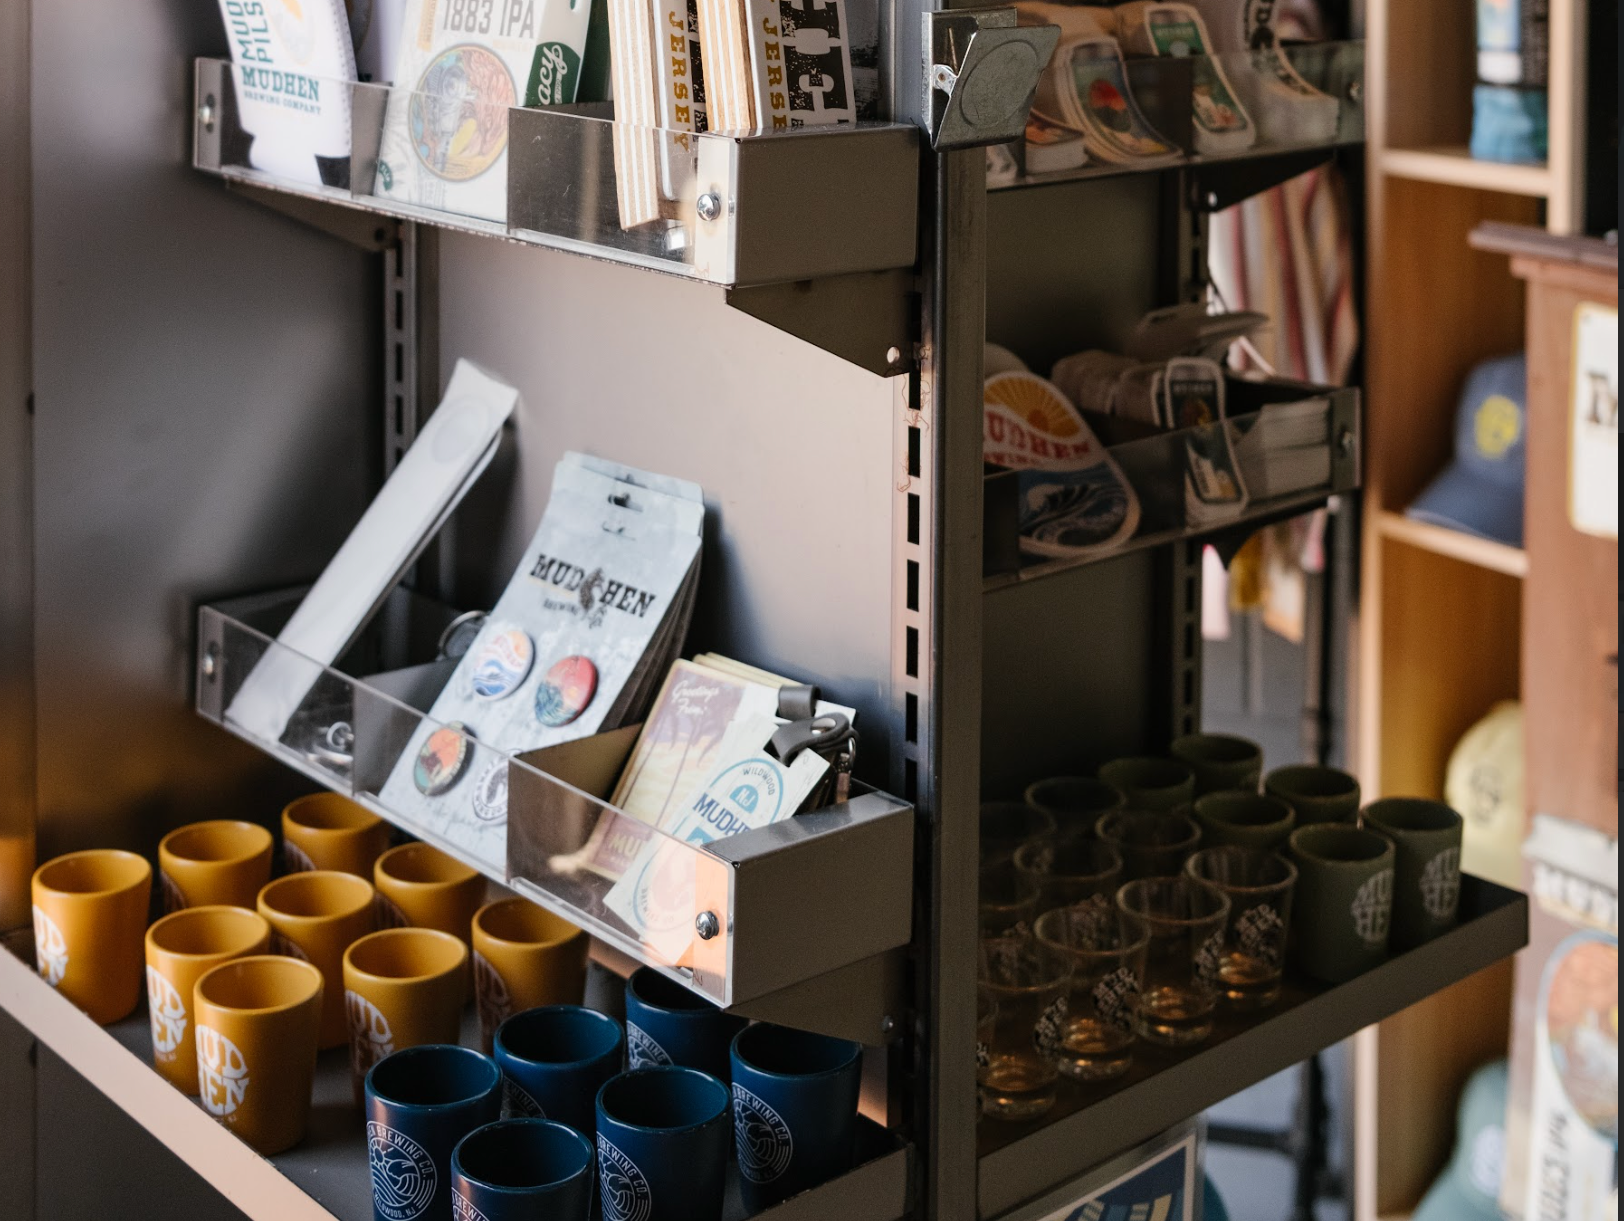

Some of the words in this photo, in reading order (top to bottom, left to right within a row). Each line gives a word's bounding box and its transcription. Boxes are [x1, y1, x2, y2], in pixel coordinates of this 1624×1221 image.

[244, 1, 274, 64] PILS
[241, 65, 320, 102] MUDHEN
[668, 11, 690, 152] JERSEY
[762, 17, 787, 129] JERSE
[244, 90, 281, 106] BREWING
[282, 97, 322, 115] COMPANY
[984, 410, 1090, 460] UDHEN
[671, 681, 720, 705] Greetings
[735, 786, 756, 808] NJ
[743, 766, 776, 797] WILDWOOD
[735, 1088, 780, 1126] BREWING
[376, 1125, 423, 1160] BREWING
[419, 1160, 435, 1178] CO.
[374, 1192, 406, 1219] WILDWOOD,
[405, 1206, 416, 1218] NJ
[632, 1179, 648, 1197] CO.
